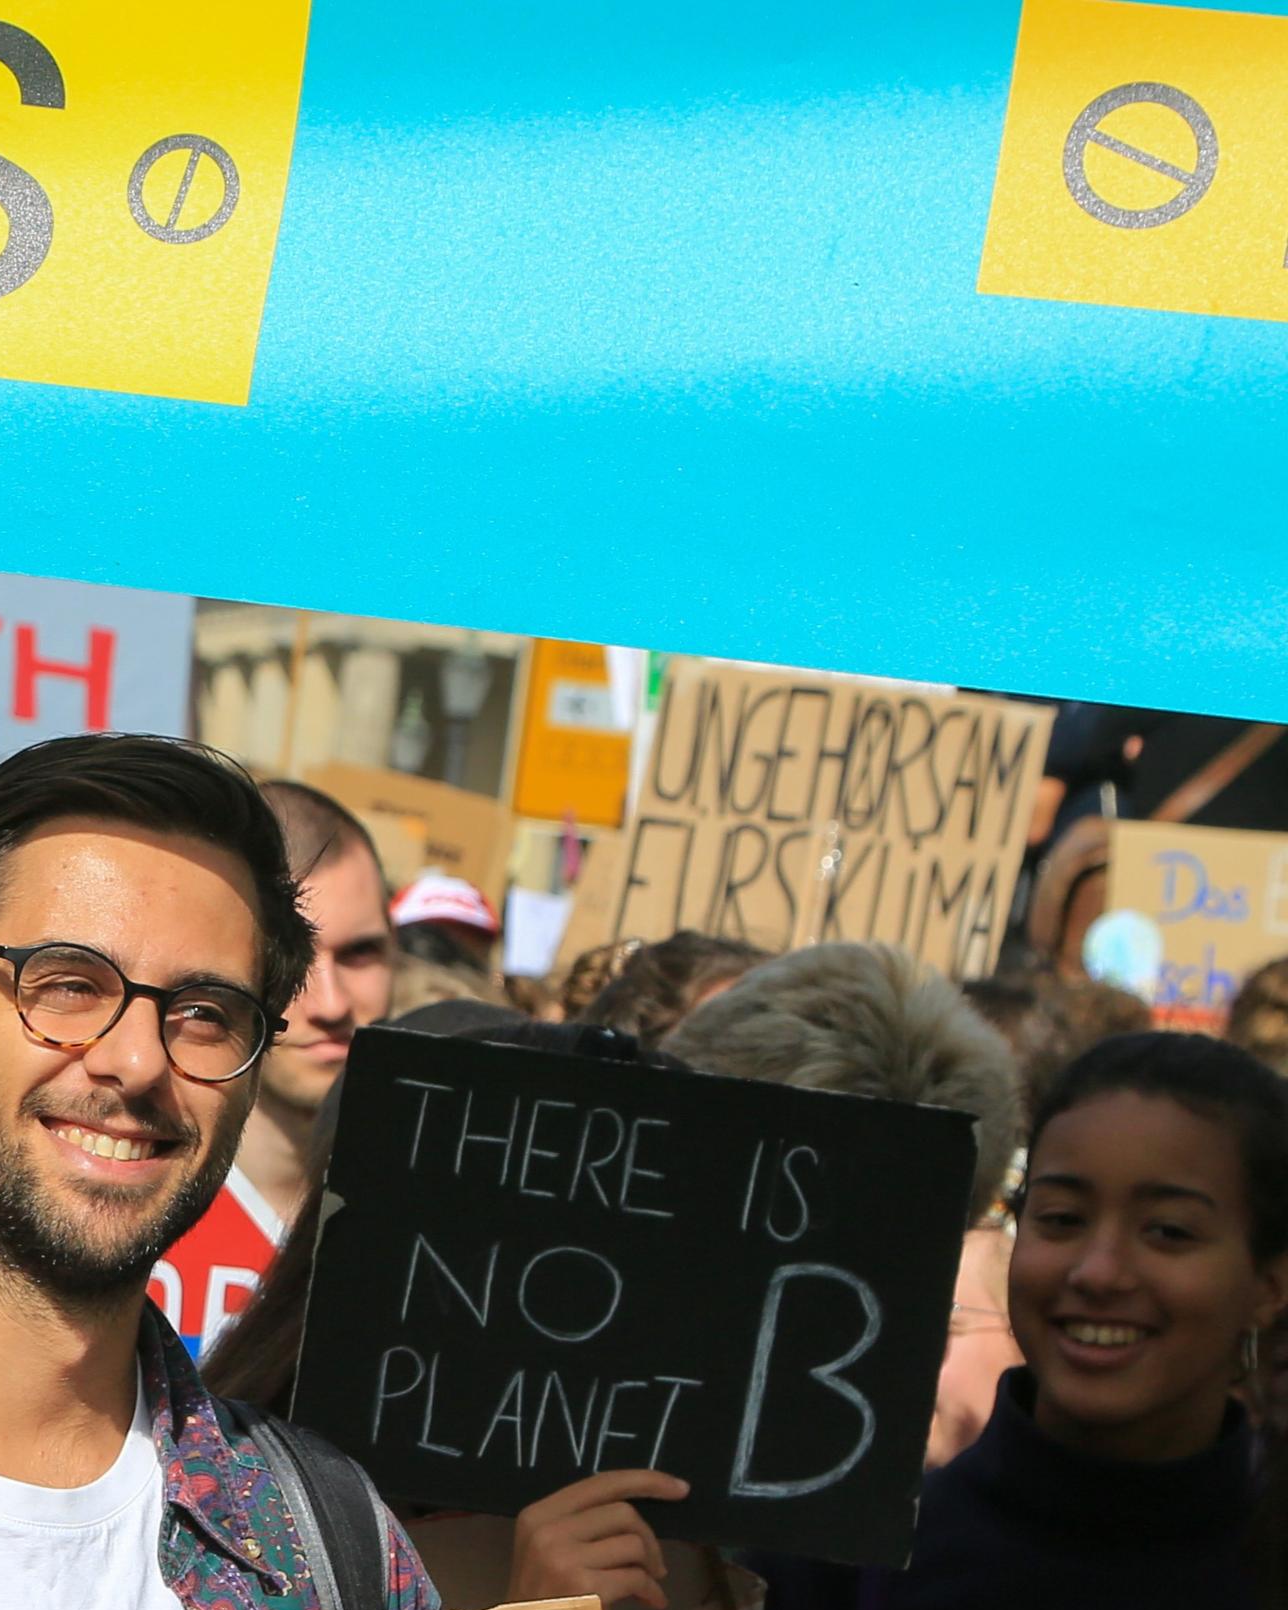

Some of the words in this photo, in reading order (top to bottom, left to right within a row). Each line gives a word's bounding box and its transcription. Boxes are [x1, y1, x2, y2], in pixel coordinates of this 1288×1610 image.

[395, 1077, 675, 1218] THERE
[740, 1138, 819, 1242] IS
[400, 1232, 623, 1342] NO
[371, 1345, 703, 1475] PLANET
[728, 1263, 883, 1499] B
